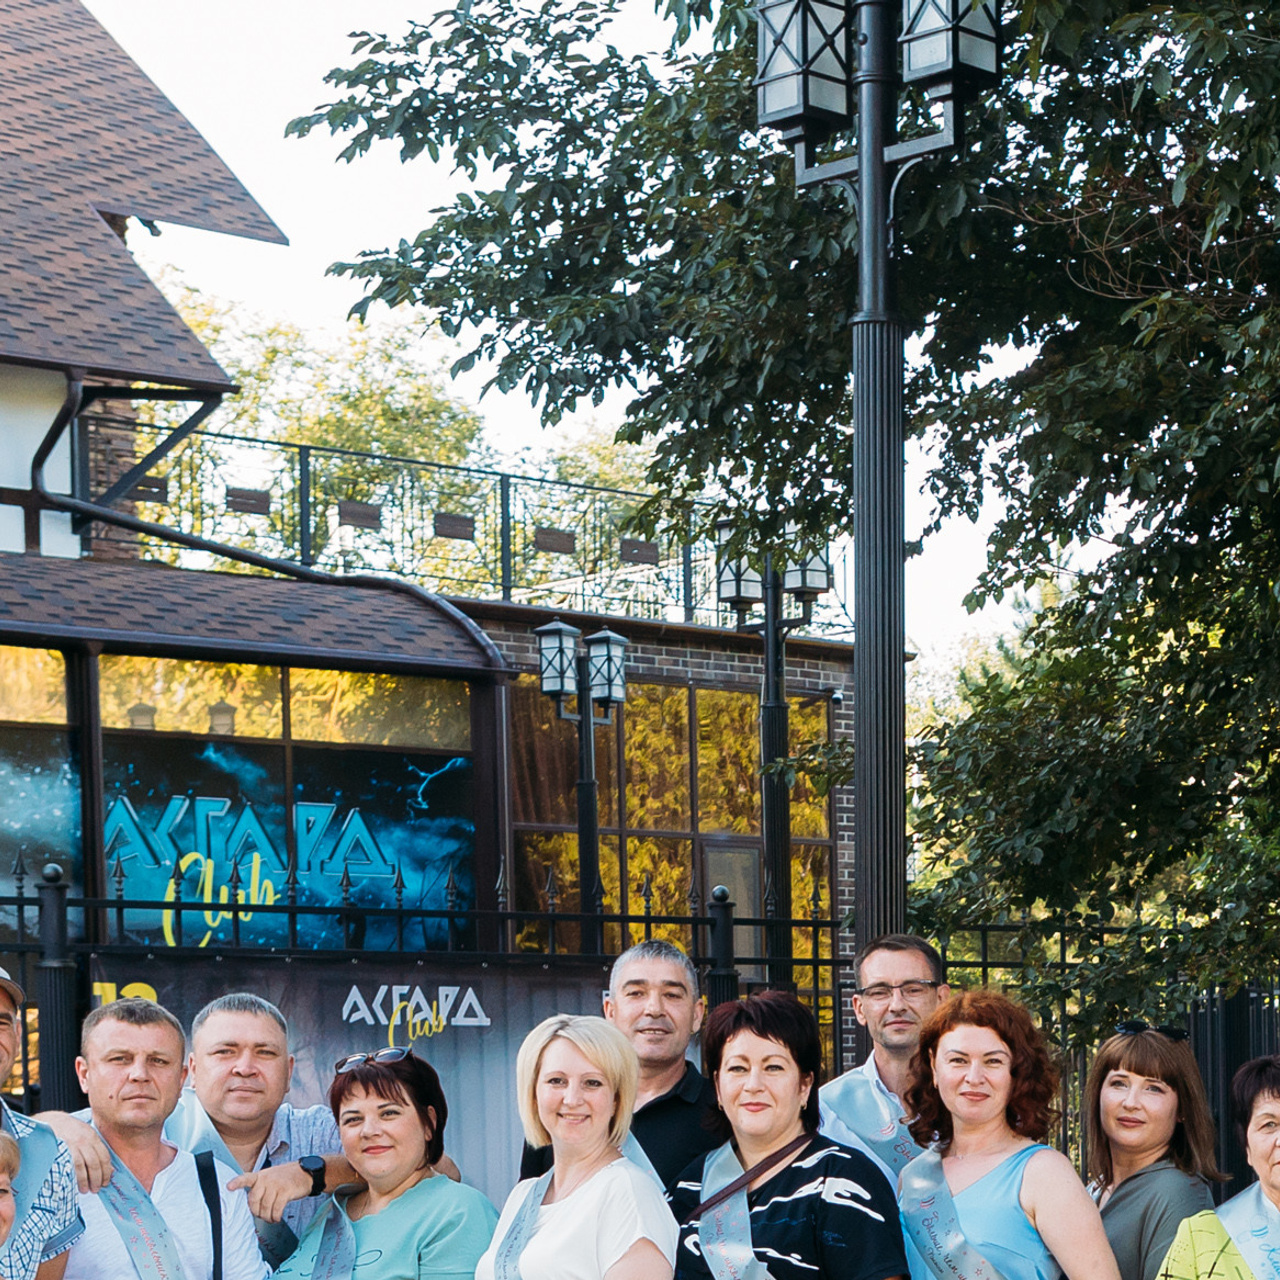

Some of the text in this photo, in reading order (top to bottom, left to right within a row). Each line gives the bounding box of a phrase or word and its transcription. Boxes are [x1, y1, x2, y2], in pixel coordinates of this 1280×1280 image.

[104, 795, 396, 877] АСГАРД
[163, 852, 281, 948] Club
[342, 985, 491, 1026] АСГАРД
[388, 1001, 446, 1048] Club
